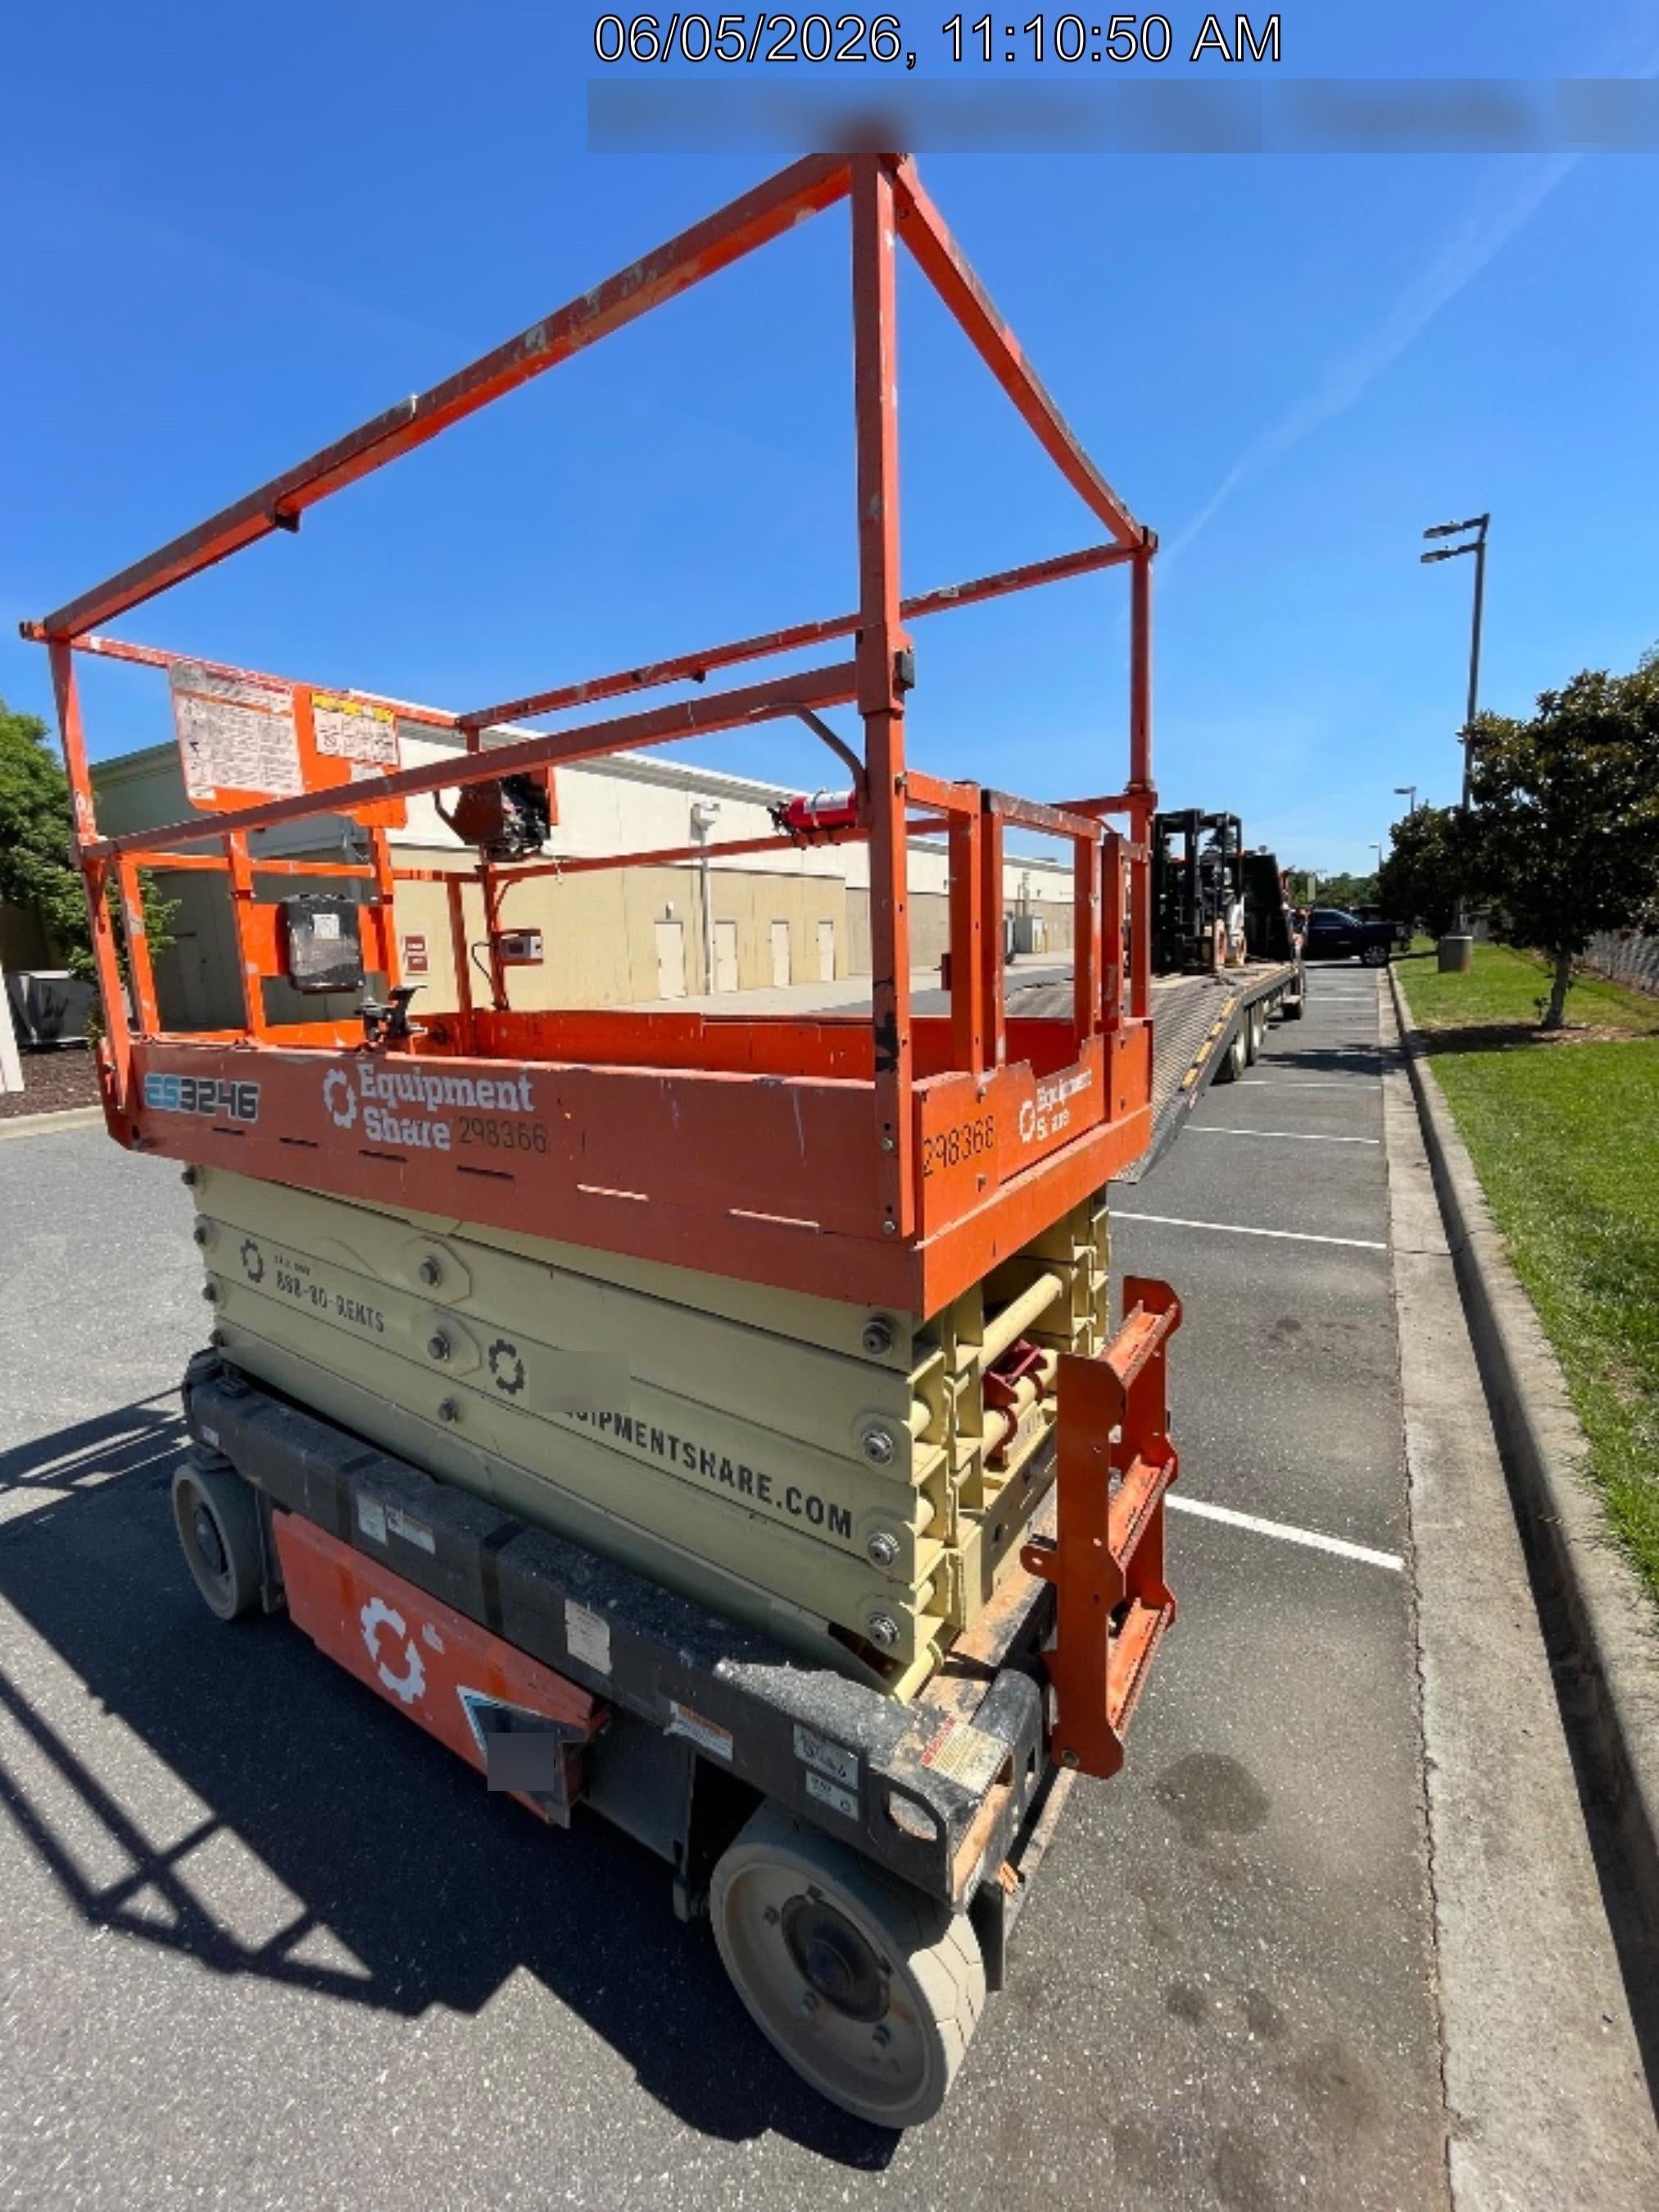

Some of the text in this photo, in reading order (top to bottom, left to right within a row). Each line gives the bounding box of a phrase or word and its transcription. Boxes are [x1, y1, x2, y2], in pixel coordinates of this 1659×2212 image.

[145, 1073, 260, 1122] ES3246
[358, 1065, 534, 1111] Equipment
[363, 1106, 451, 1150] Share
[459, 1115, 547, 1154] 298366
[1036, 1108, 1070, 1140] Sare
[564, 1412, 853, 1539] IPMENTSHARE.COM
